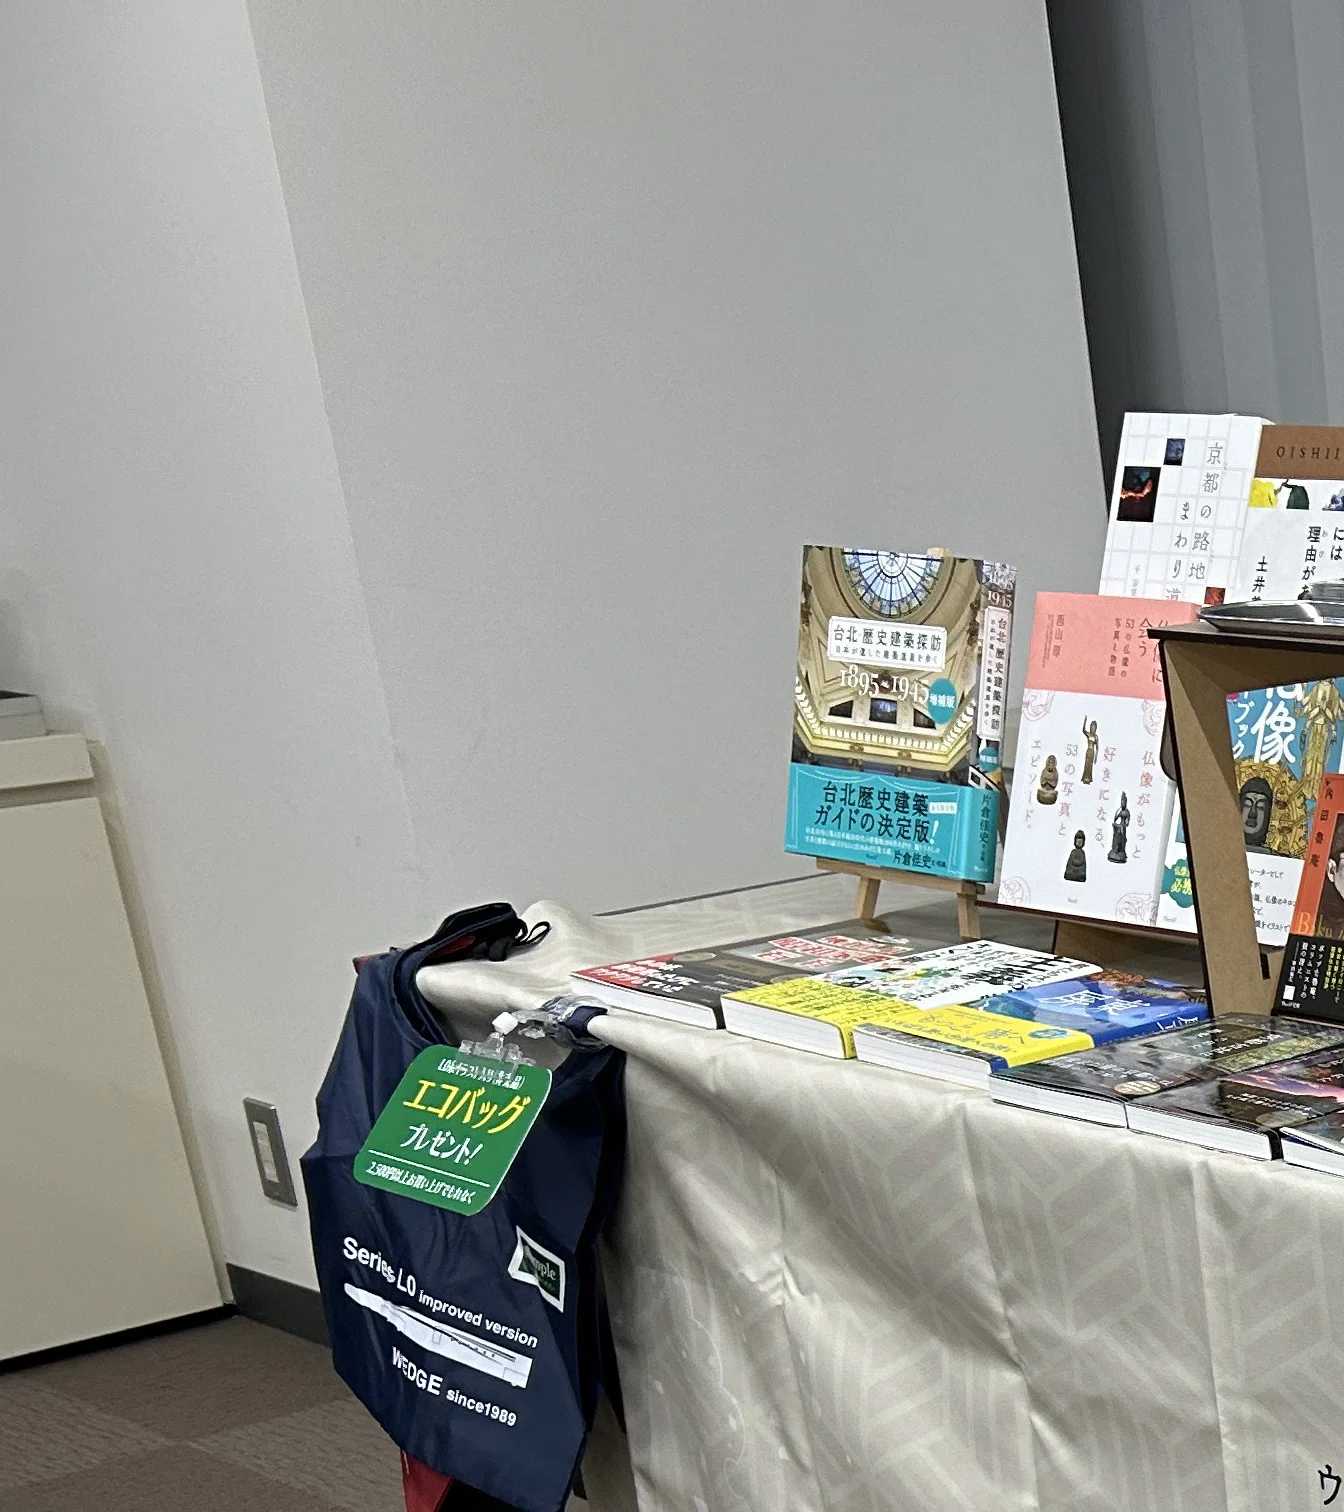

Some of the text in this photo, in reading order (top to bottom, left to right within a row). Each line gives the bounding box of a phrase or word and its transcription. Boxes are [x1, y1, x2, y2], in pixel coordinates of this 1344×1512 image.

[1187, 442, 1223, 580] 京都の路地
[1330, 526, 1344, 561] には
[823, 780, 930, 817] 台北歴史建築
[1058, 744, 1078, 836] 53の写真と
[1095, 746, 1116, 848] 好きになる、
[1132, 751, 1155, 859] 仏像がもっと
[400, 1123, 484, 1165] プレゼント！
[403, 1079, 532, 1134] エコバッグ
[342, 1236, 397, 1284] Series
[419, 1288, 482, 1328] improved
[485, 1314, 539, 1349] version
[391, 1346, 518, 1428] WEDGE since1989
